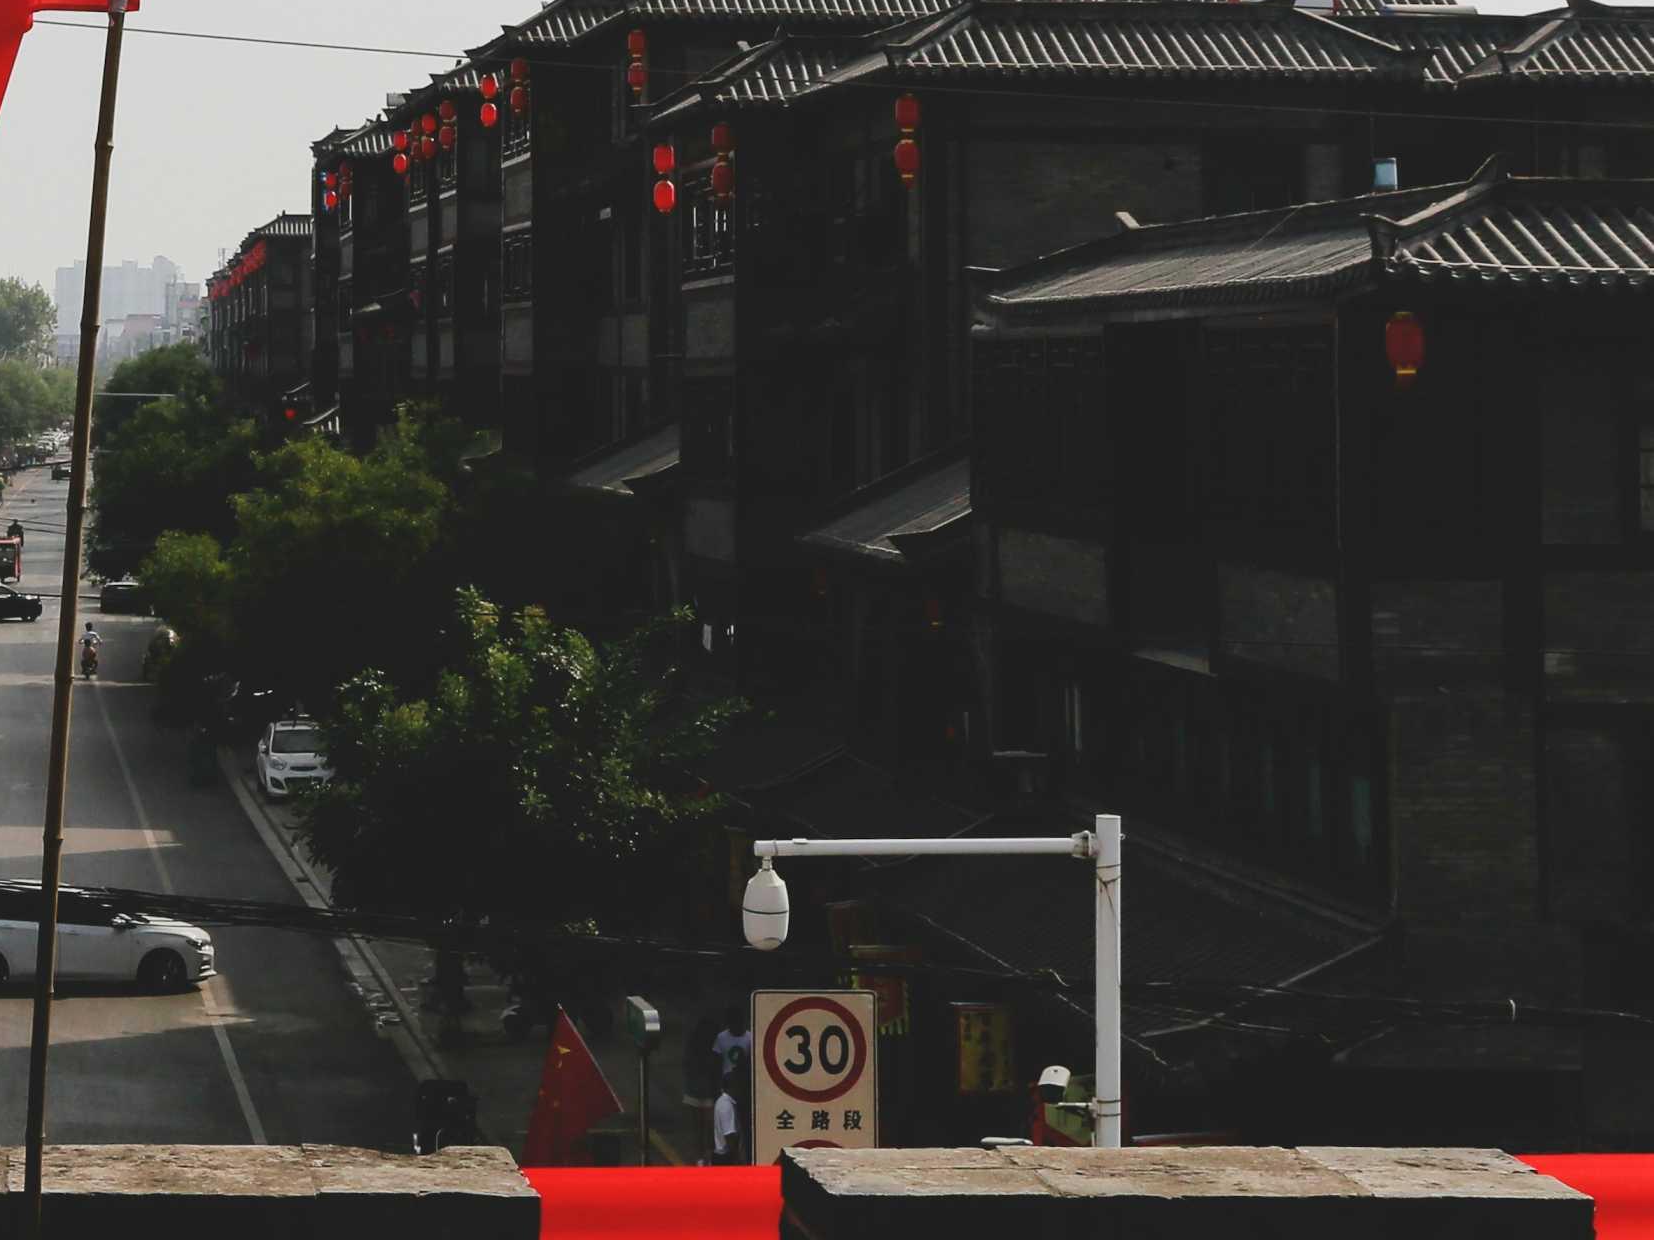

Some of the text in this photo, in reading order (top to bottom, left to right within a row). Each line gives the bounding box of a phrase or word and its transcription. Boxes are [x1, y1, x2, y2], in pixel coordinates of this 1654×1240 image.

[784, 1025, 849, 1075] 30
[776, 1109, 862, 1131] 全路段
